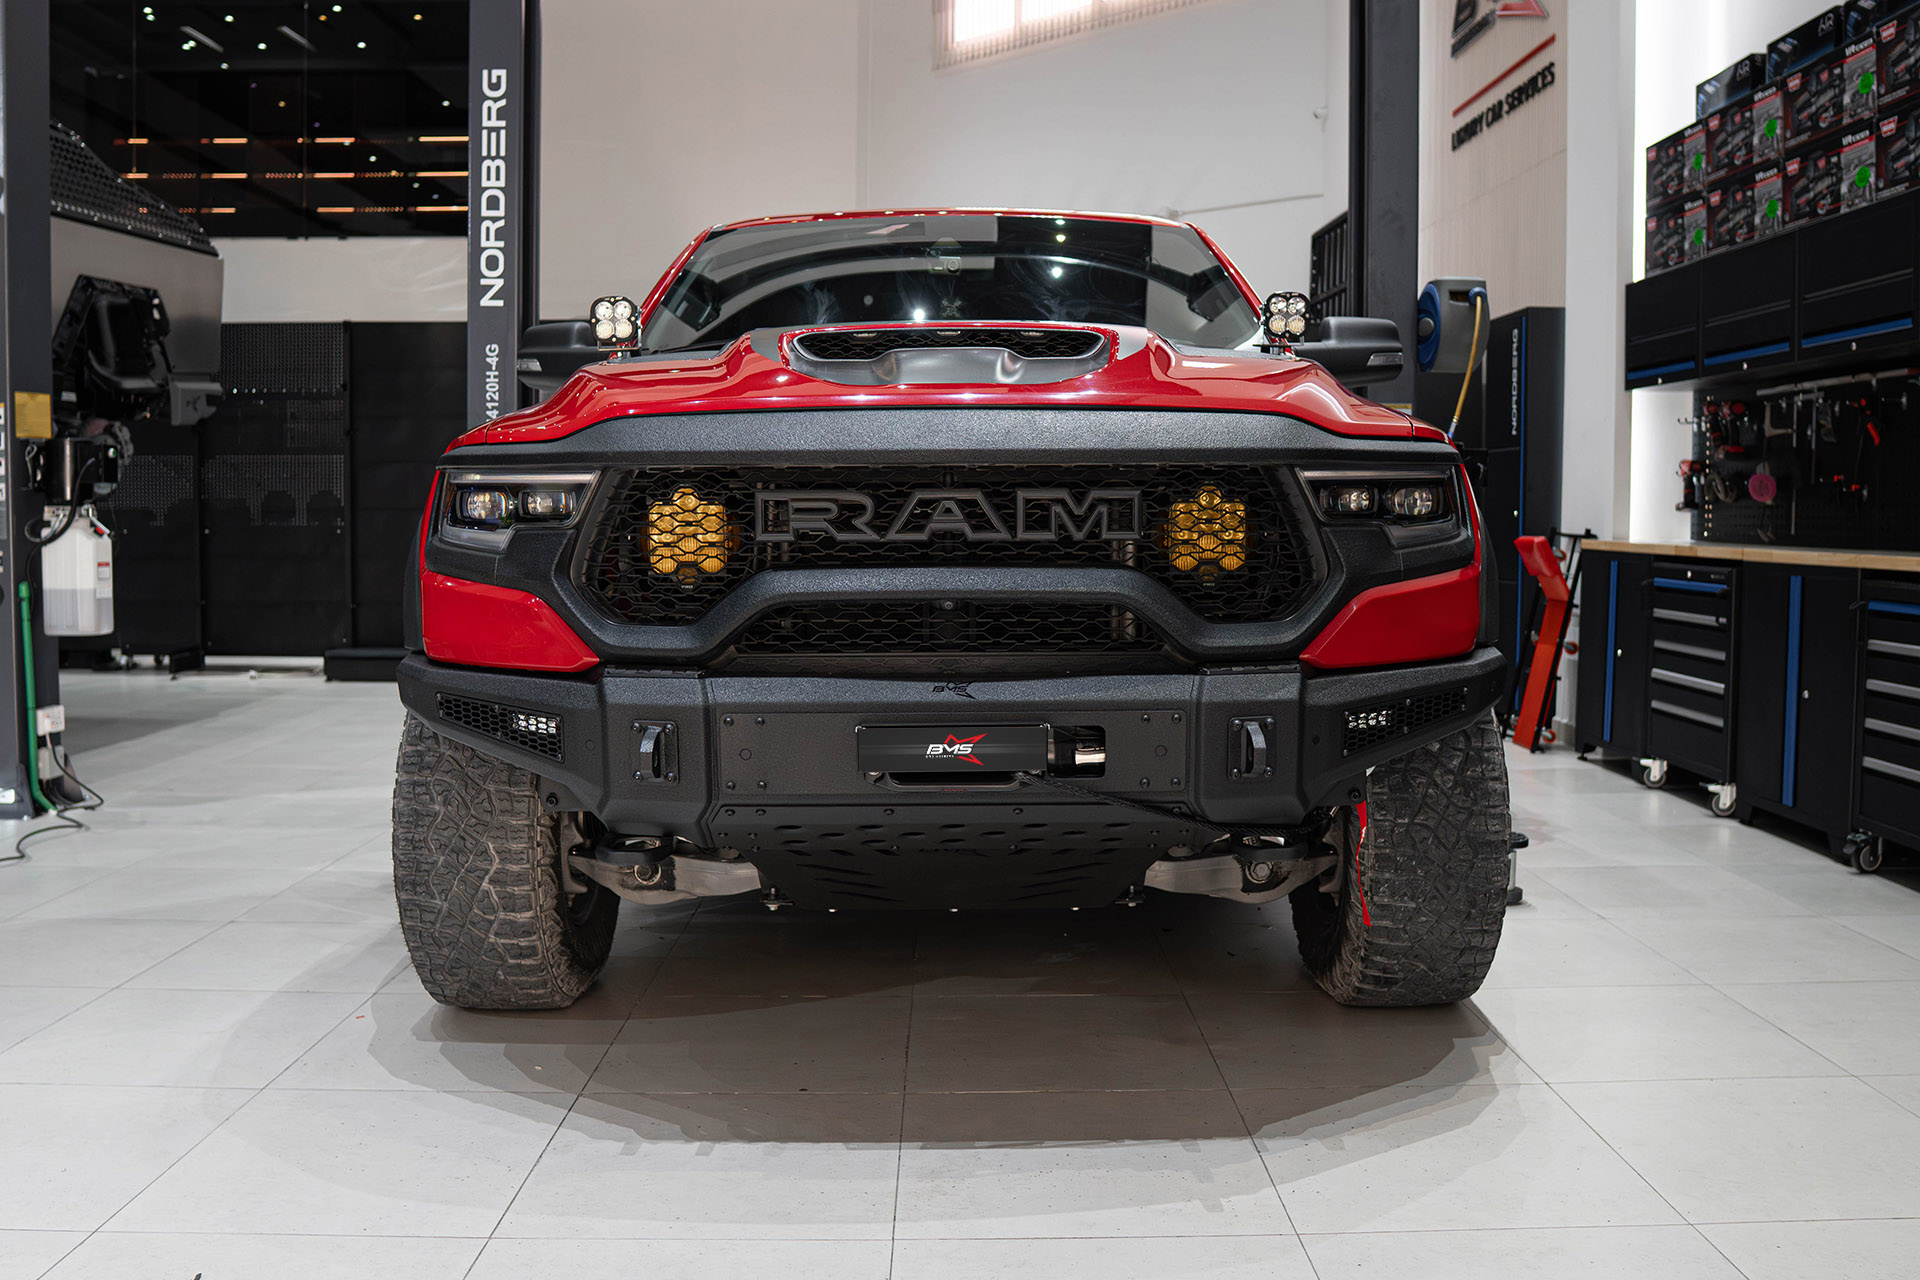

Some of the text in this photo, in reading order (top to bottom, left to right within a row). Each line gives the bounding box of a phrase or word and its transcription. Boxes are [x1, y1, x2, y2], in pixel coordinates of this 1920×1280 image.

[479, 68, 507, 307] NORDBERG
[485, 343, 499, 422] 4120H-4G
[754, 488, 1142, 541] RAM
[926, 743, 974, 754] BMS
